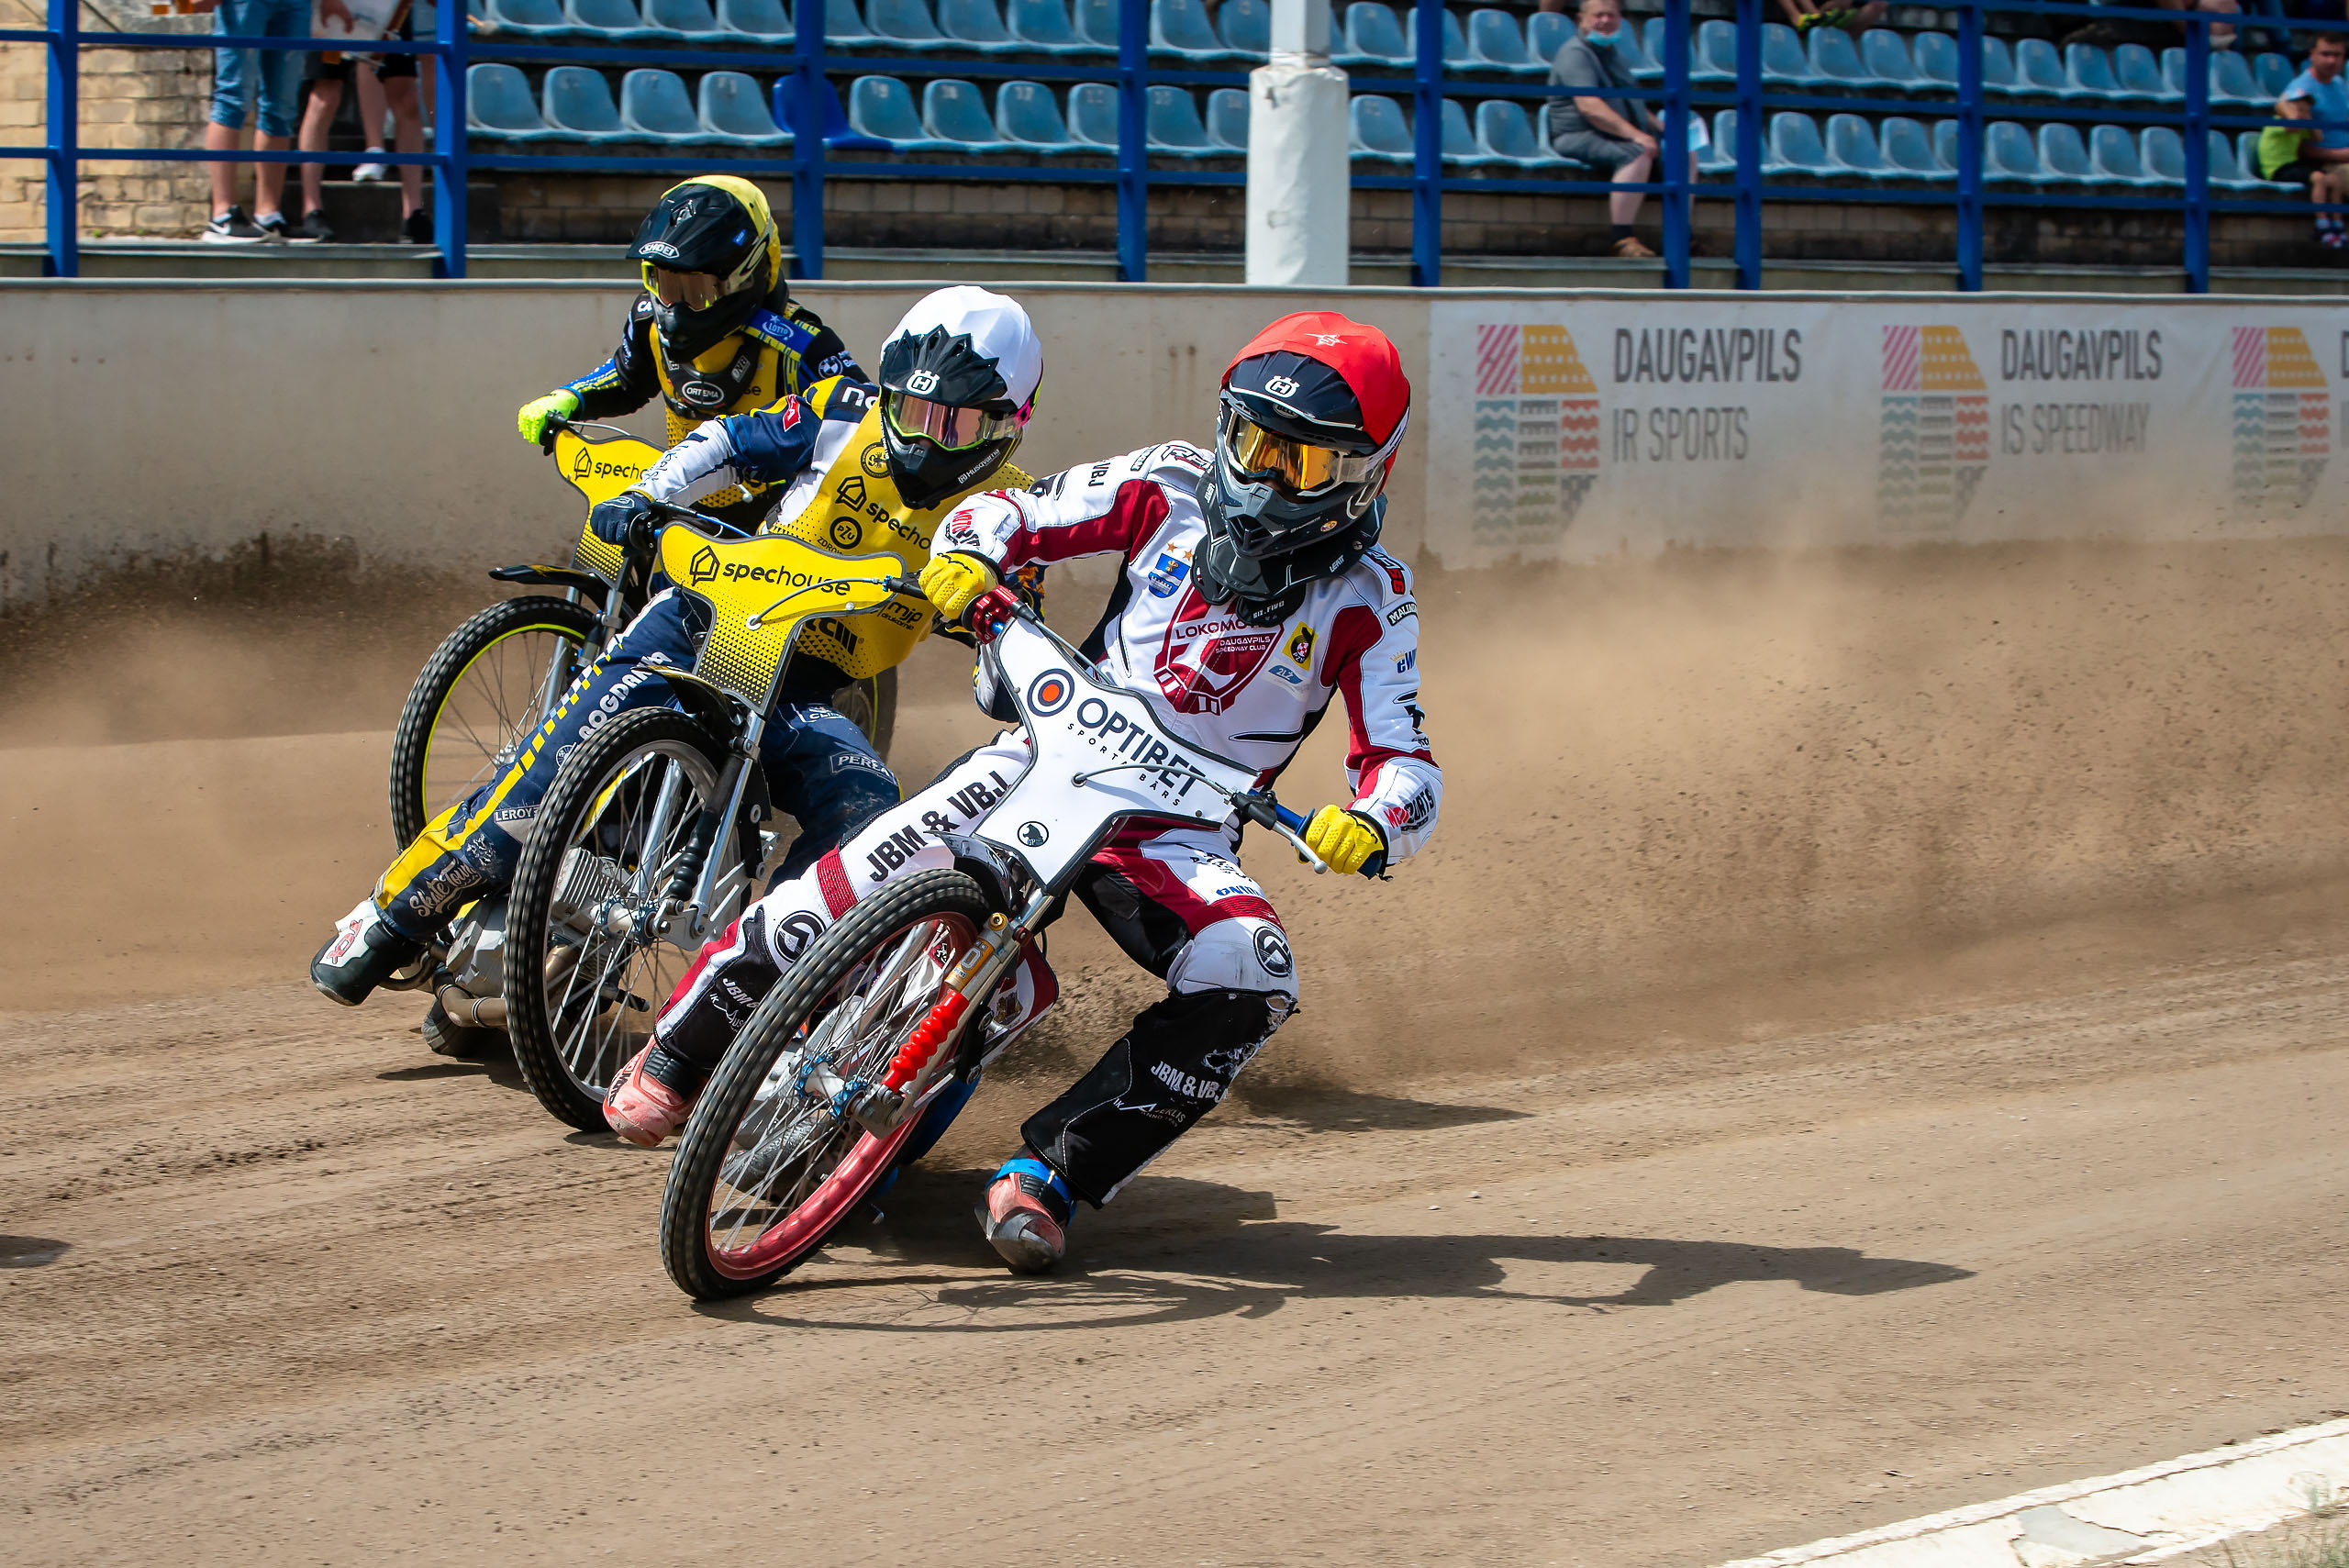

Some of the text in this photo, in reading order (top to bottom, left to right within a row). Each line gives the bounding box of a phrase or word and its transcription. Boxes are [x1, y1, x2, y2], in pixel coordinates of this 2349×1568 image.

[643, 242, 675, 258] SHOEI
[768, 321, 788, 335] LOTTO
[1614, 328, 1802, 384] DAUGAVPILS
[2001, 328, 2164, 382] DAUGAVPILS
[685, 386, 719, 399] ORTEMA
[1612, 406, 1750, 462] IR SPORTS
[2001, 403, 2152, 455] IS SPEEDWAY
[966, 448, 1001, 479] Husqvarna
[836, 524, 856, 540] PZU
[722, 562, 851, 596] spechouse
[887, 601, 923, 623] mjp
[1215, 645, 1248, 654] SPEEDWAY
[1219, 636, 1271, 647] DAUGAVPILS
[1076, 697, 1206, 797] OPTIBET
[866, 770, 1012, 882] JBM & VBJ
[409, 859, 478, 917] Skate Town
[326, 918, 363, 964] FOX
[722, 977, 752, 1006] JBM
[1151, 1061, 1185, 1091] JBM
[1182, 1075, 1197, 1097] &
